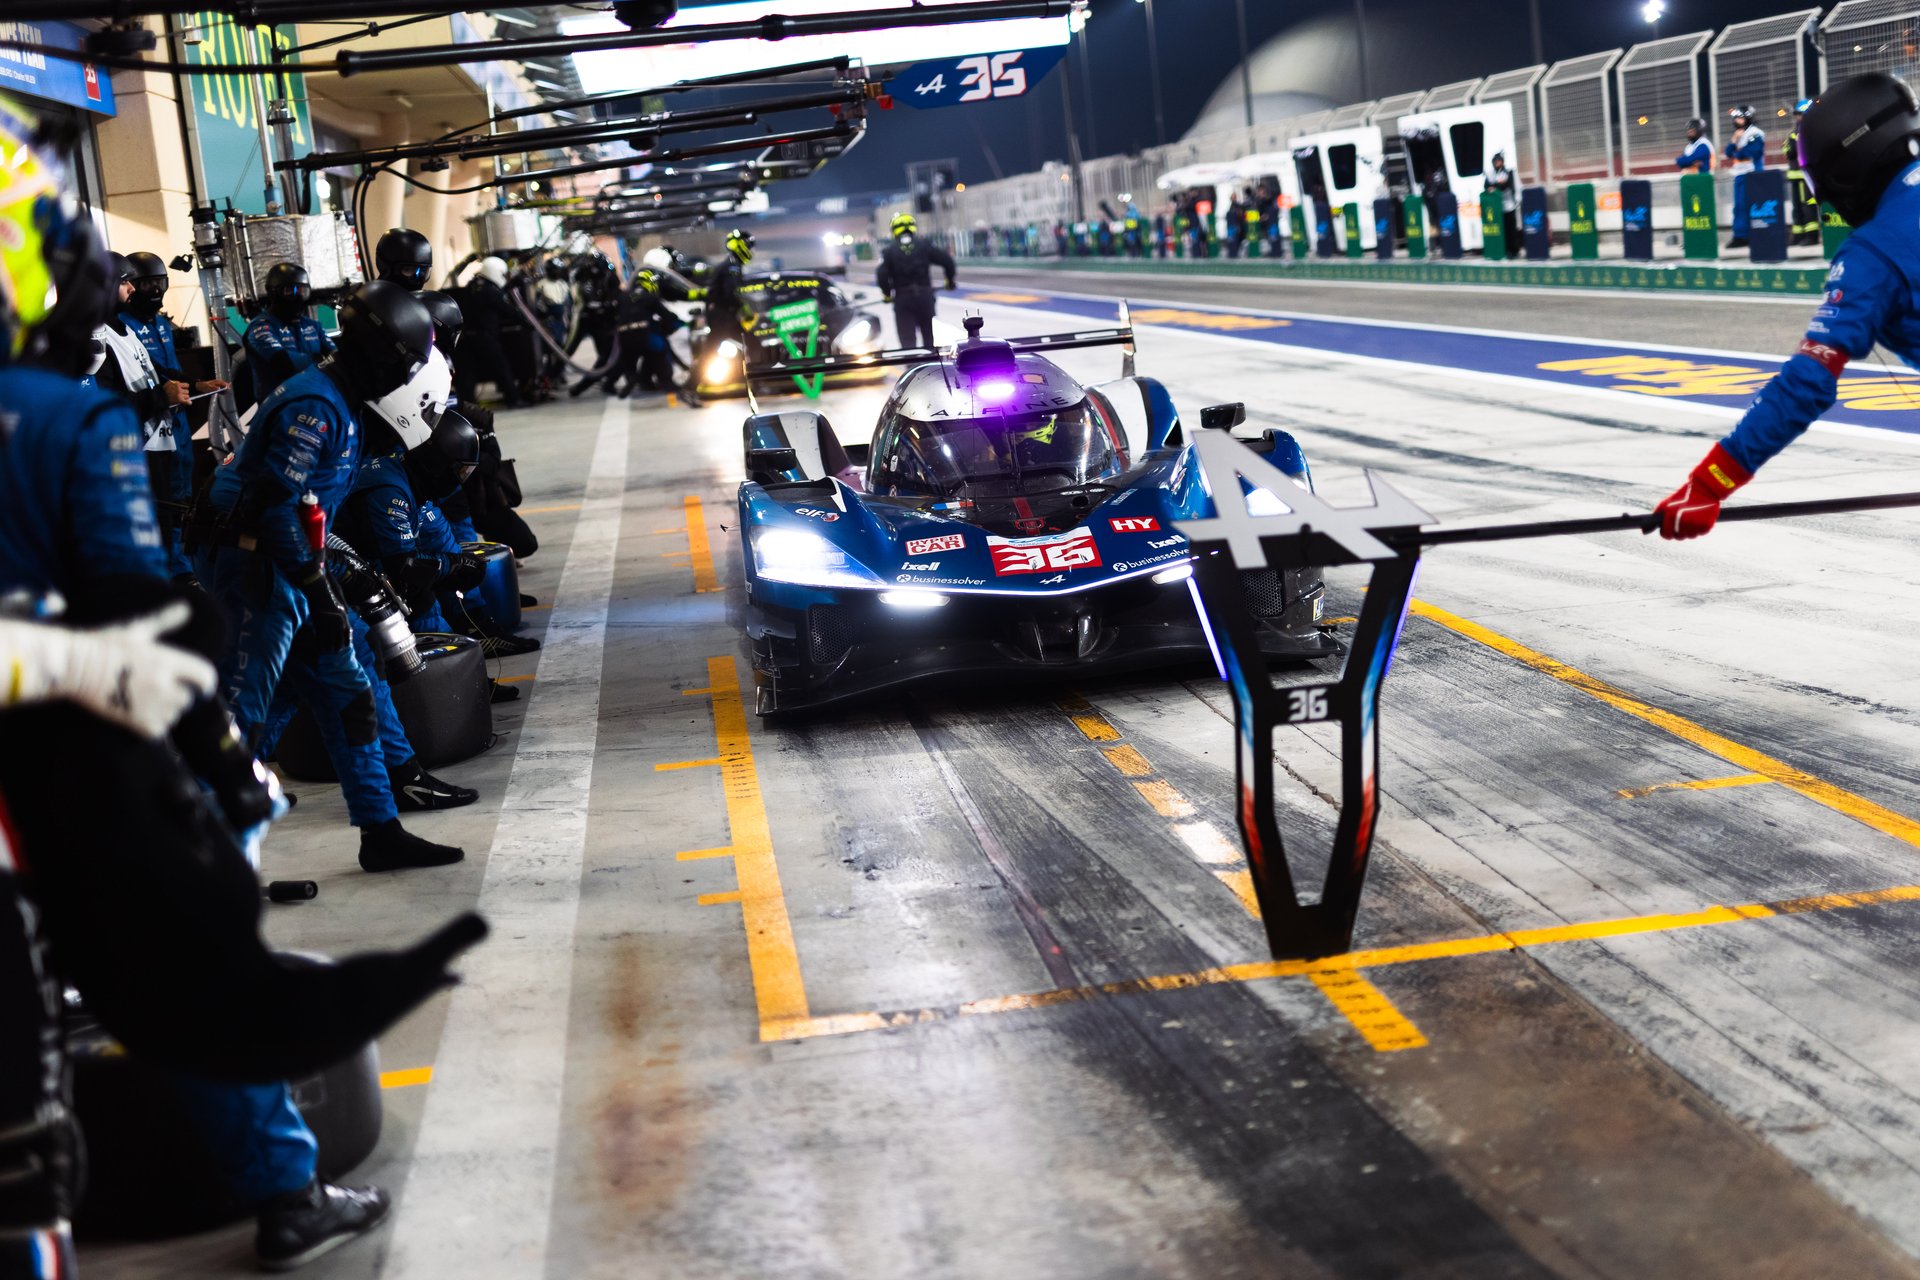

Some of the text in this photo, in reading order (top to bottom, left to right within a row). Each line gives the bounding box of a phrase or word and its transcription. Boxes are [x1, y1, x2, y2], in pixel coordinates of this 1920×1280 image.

[955, 51, 1027, 101] 35
[930, 396, 1070, 418] ALPINE
[297, 414, 318, 427] elf
[794, 508, 825, 518] elf
[1111, 518, 1153, 531] HY
[909, 535, 959, 547] HYPER
[910, 540, 961, 554] CAR
[1146, 534, 1187, 549] ixell
[994, 538, 1097, 573] 36
[1126, 548, 1190, 568] businessolve
[900, 561, 941, 571] ixell
[910, 575, 987, 585] businessolver
[228, 606, 255, 706] ALPIN
[1288, 687, 1328, 722] 36
